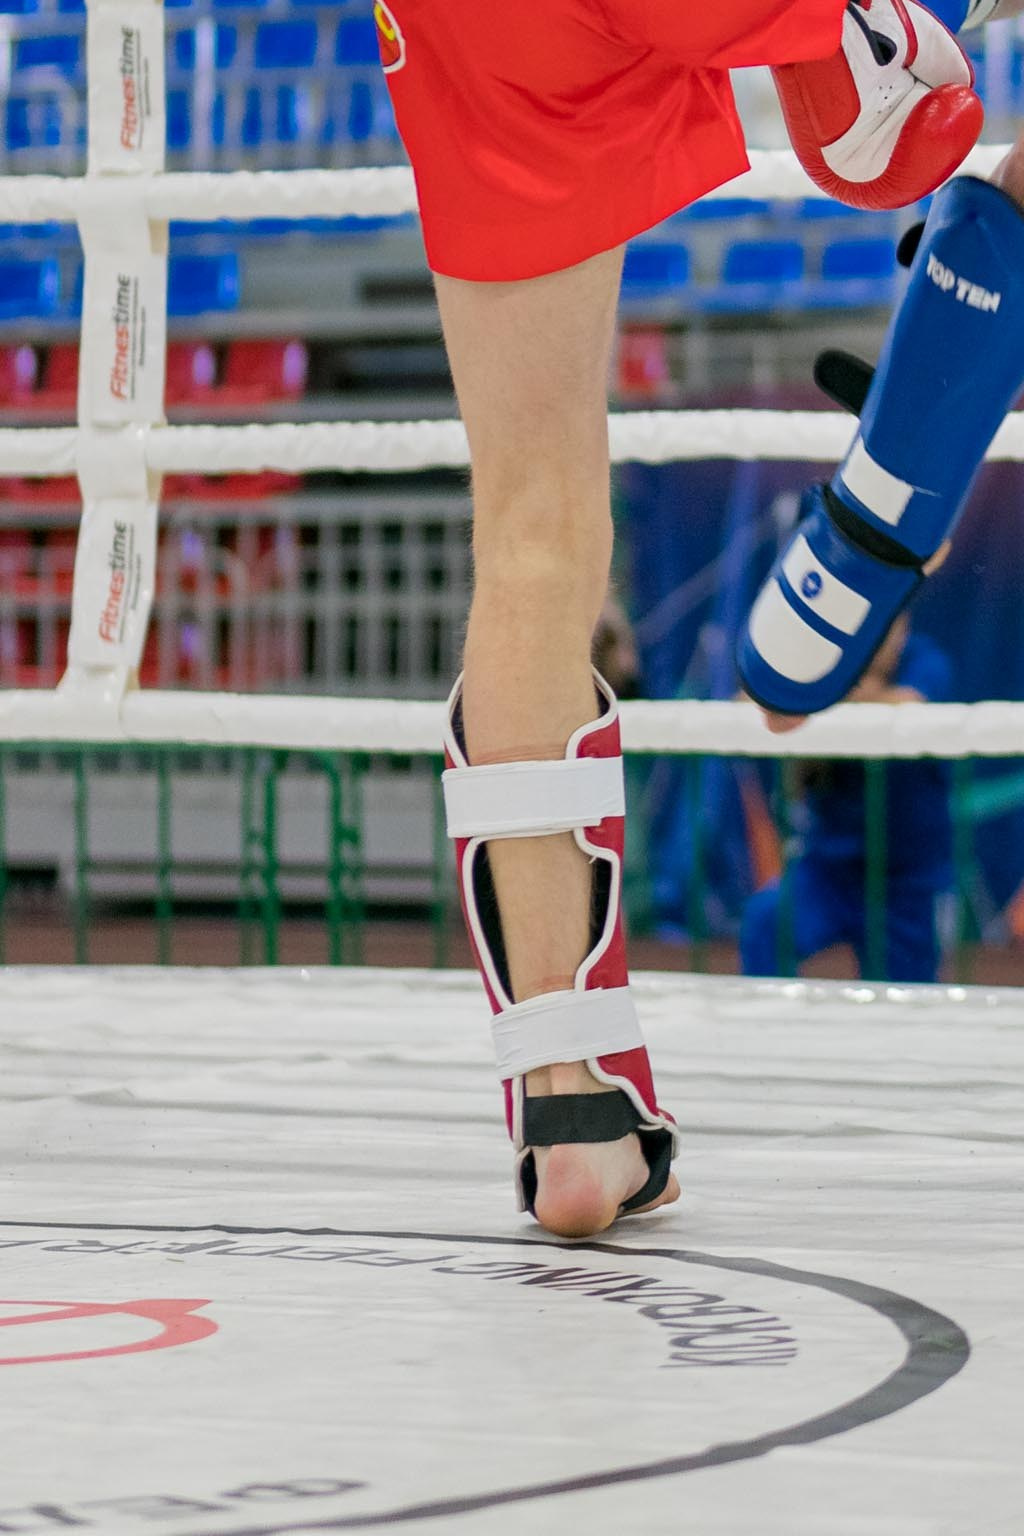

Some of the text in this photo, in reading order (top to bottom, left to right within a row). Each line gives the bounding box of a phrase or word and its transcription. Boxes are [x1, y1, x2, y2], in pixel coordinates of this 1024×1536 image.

[926, 250, 1001, 315] TOP TEN
[431, 1261, 798, 1368] KICKBOXING
